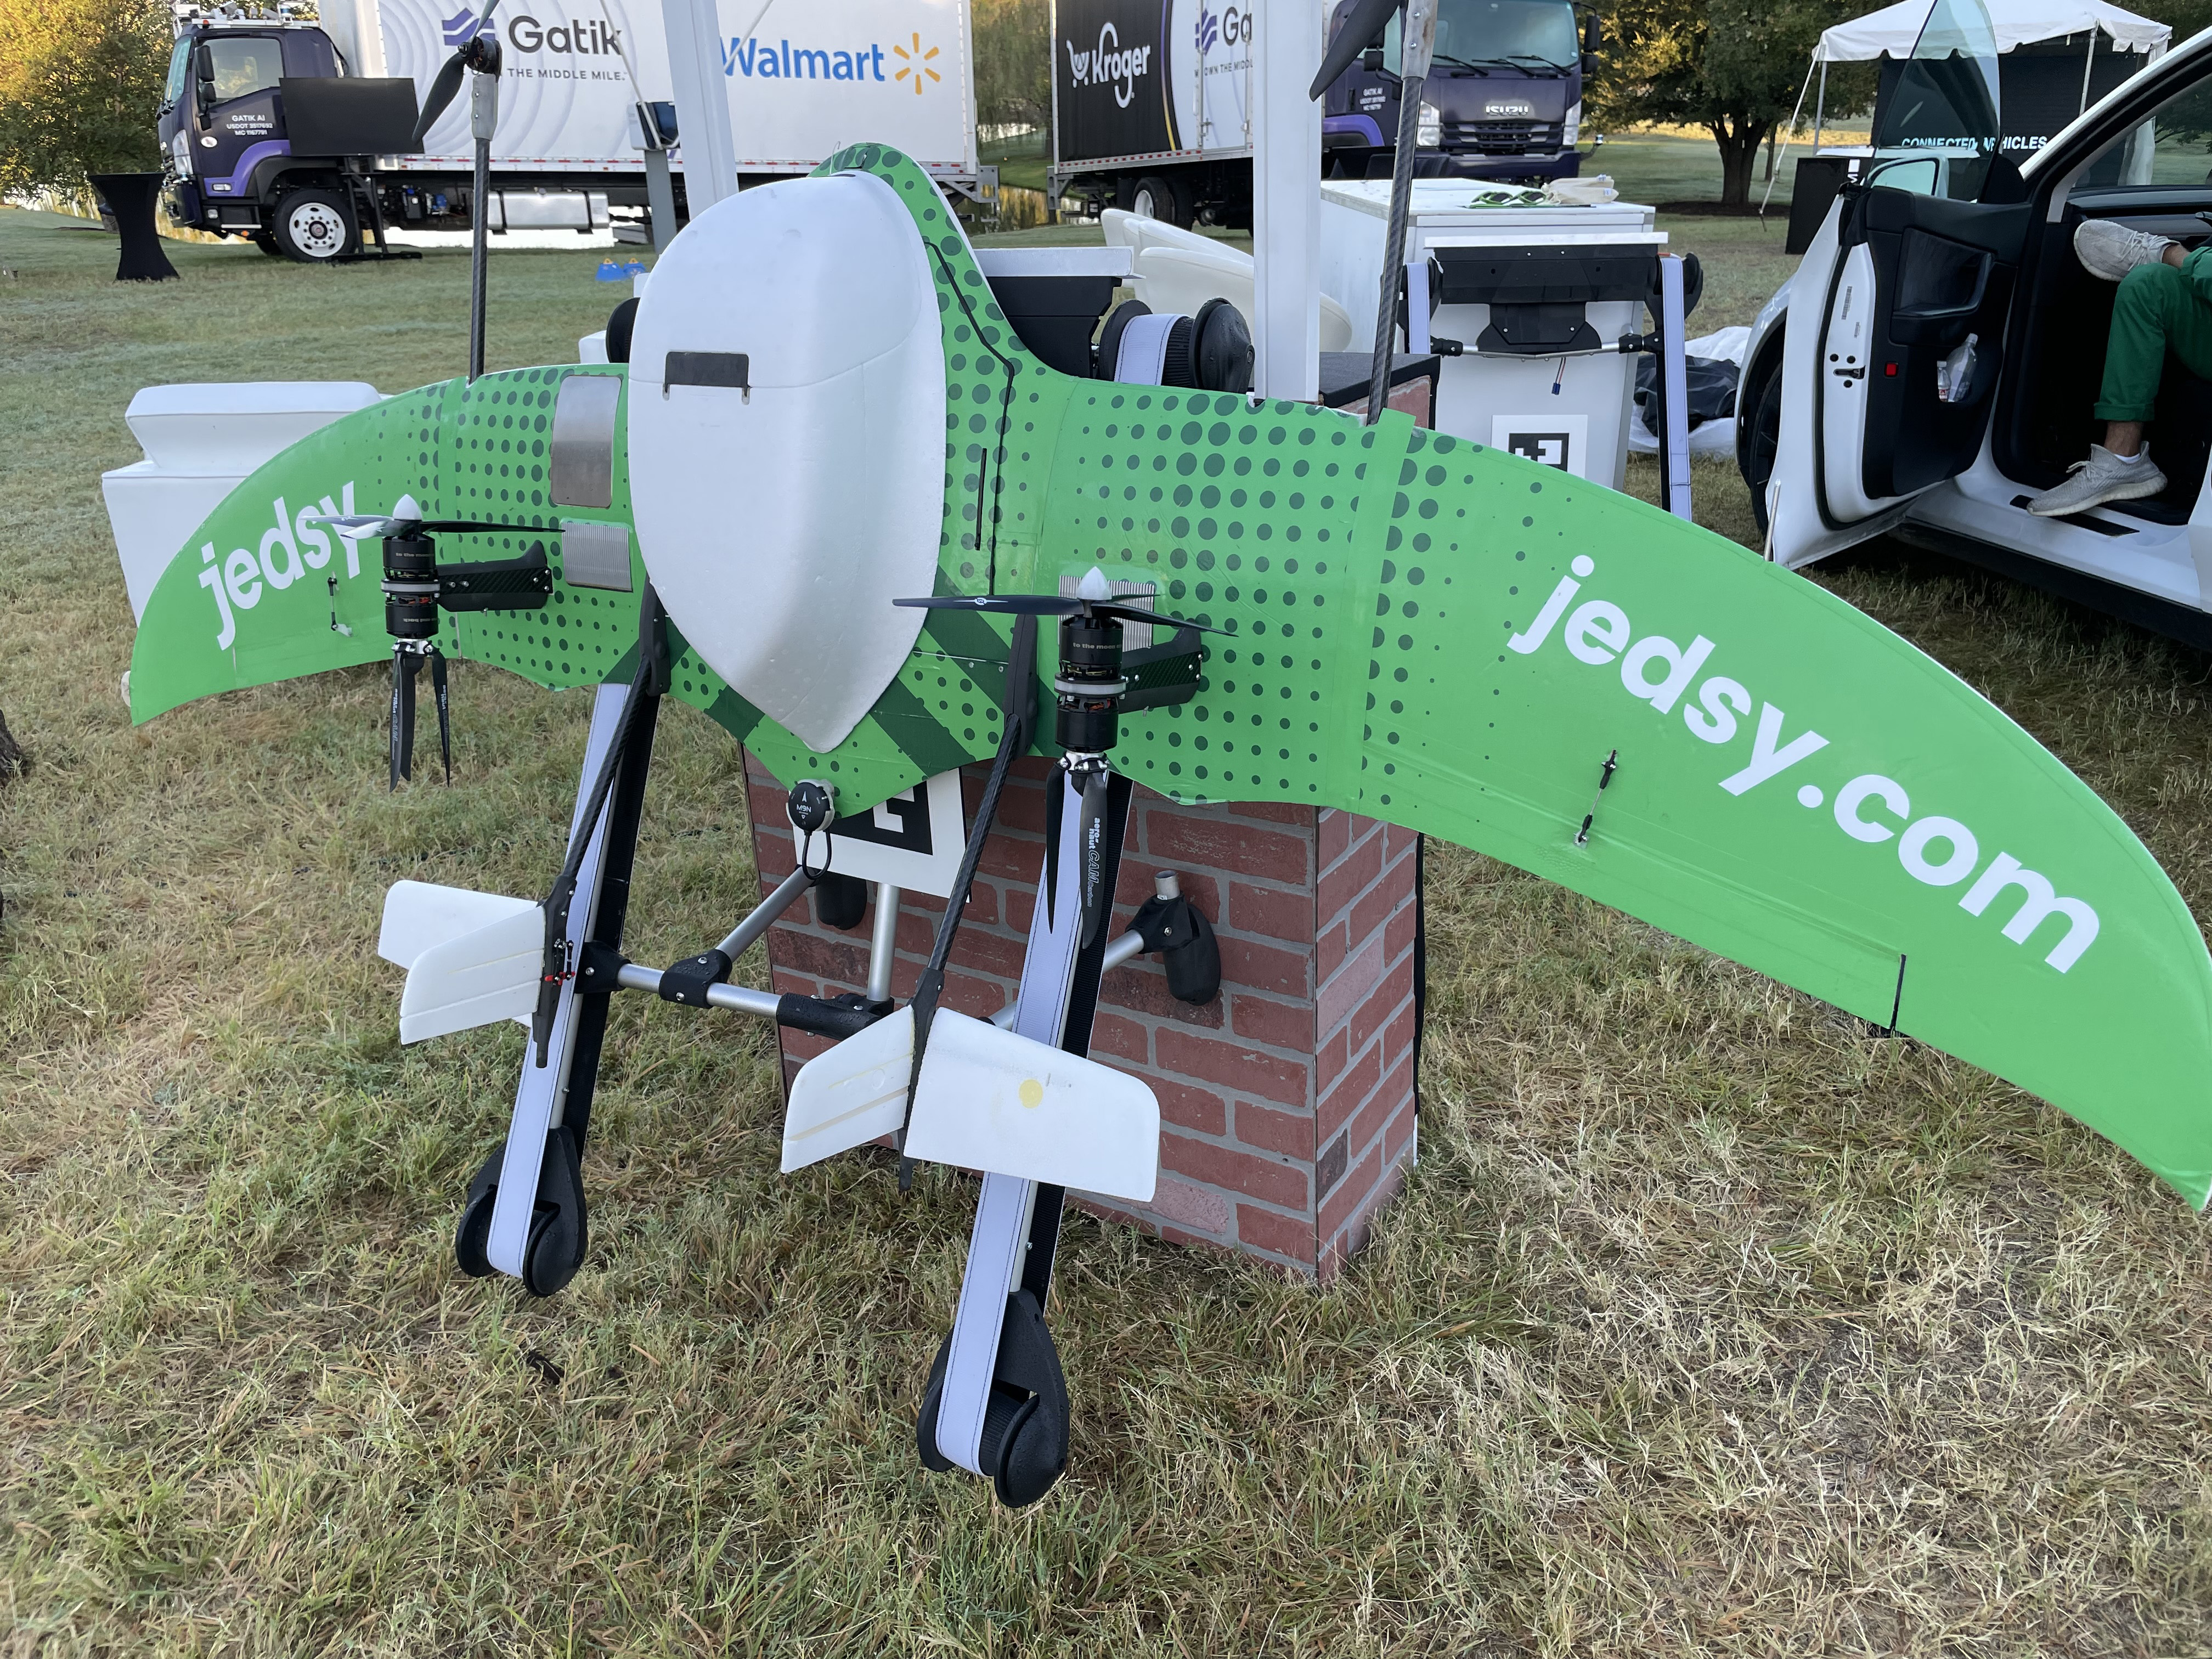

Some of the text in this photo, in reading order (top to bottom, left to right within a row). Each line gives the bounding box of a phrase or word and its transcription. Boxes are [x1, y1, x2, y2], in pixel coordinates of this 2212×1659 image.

[509, 15, 622, 55] Gatik
[1223, 7, 1252, 46] Ga
[507, 68, 533, 78] THE
[538, 69, 587, 80] MIDDLE
[720, 36, 885, 82] Walmart
[1092, 21, 1151, 108] Kroger
[1233, 59, 1253, 71] MIDDL
[1485, 105, 1529, 116] ISUZU
[199, 481, 360, 651] jedsy
[1506, 555, 2100, 974] jedsy.com
[796, 804, 811, 813] M9N
[1088, 850, 1100, 884] CAM
